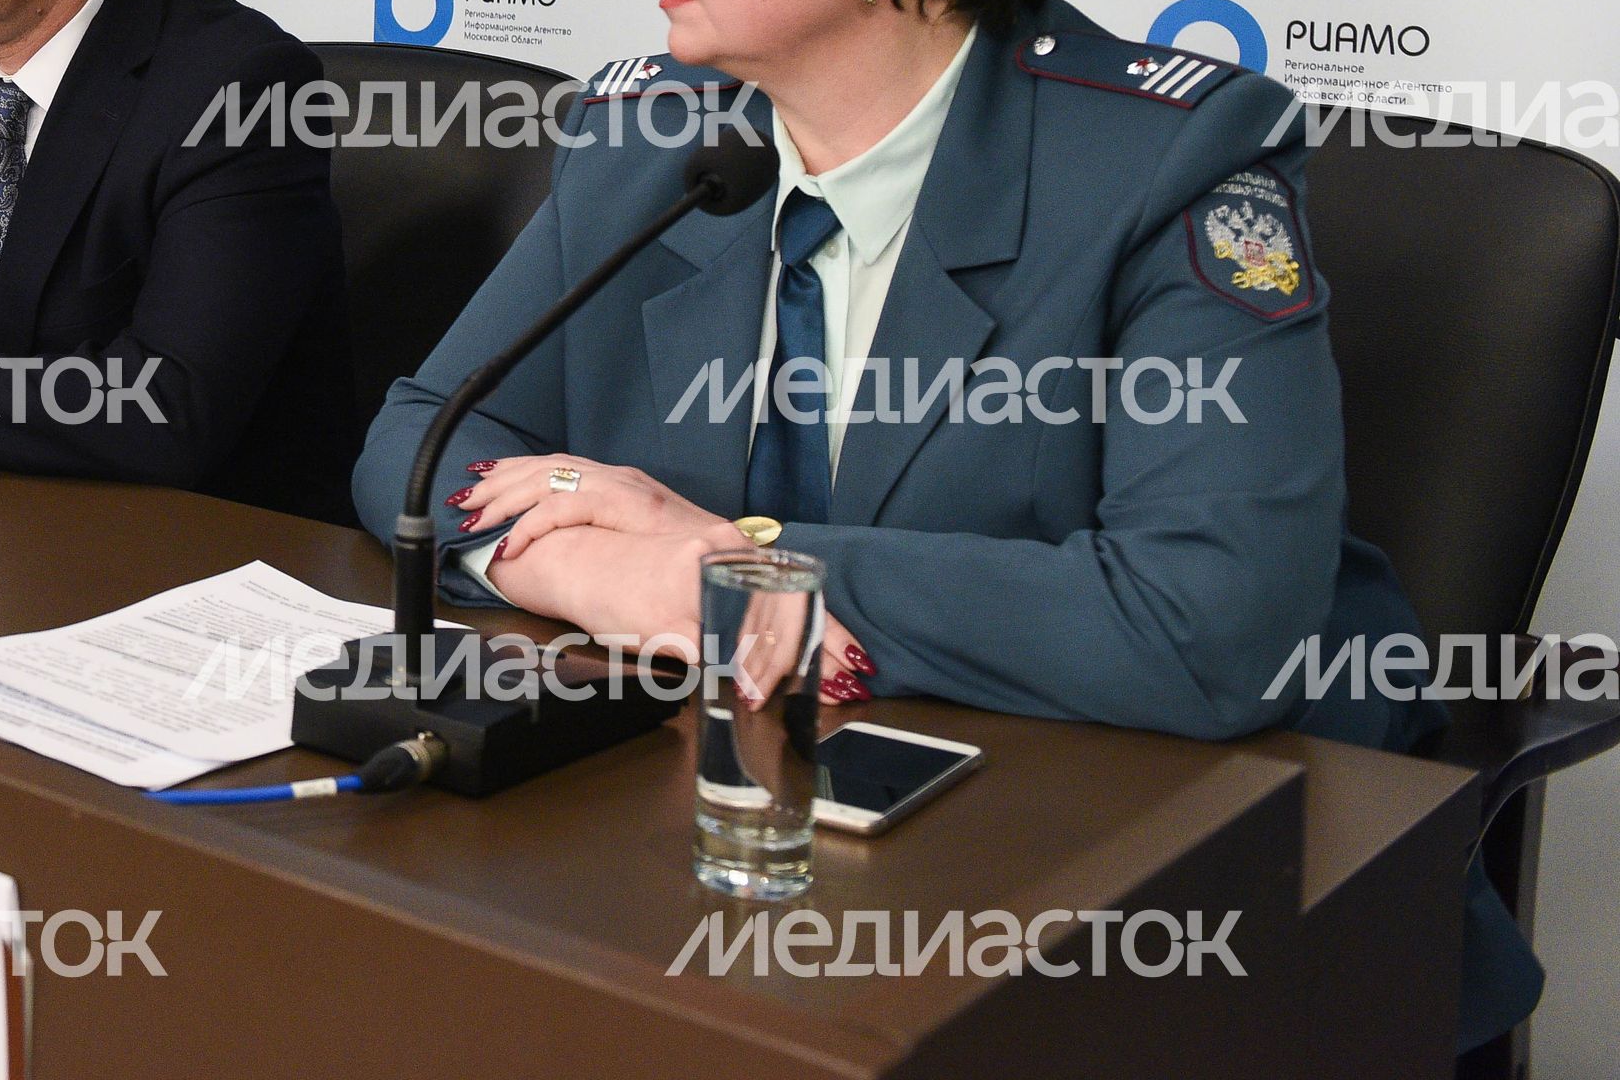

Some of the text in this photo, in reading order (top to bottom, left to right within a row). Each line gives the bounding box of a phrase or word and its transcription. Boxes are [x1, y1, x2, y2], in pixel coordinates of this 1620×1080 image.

[464, 9, 516, 20] Региональное
[464, 21, 572, 36] Информационное Агентство
[464, 32, 543, 45] Московской Области
[1286, 20, 1430, 57] РИАМО
[1284, 59, 1365, 73] Региональное
[1284, 74, 1453, 93] Информационное Агентство
[1357, 92, 1407, 105] Области
